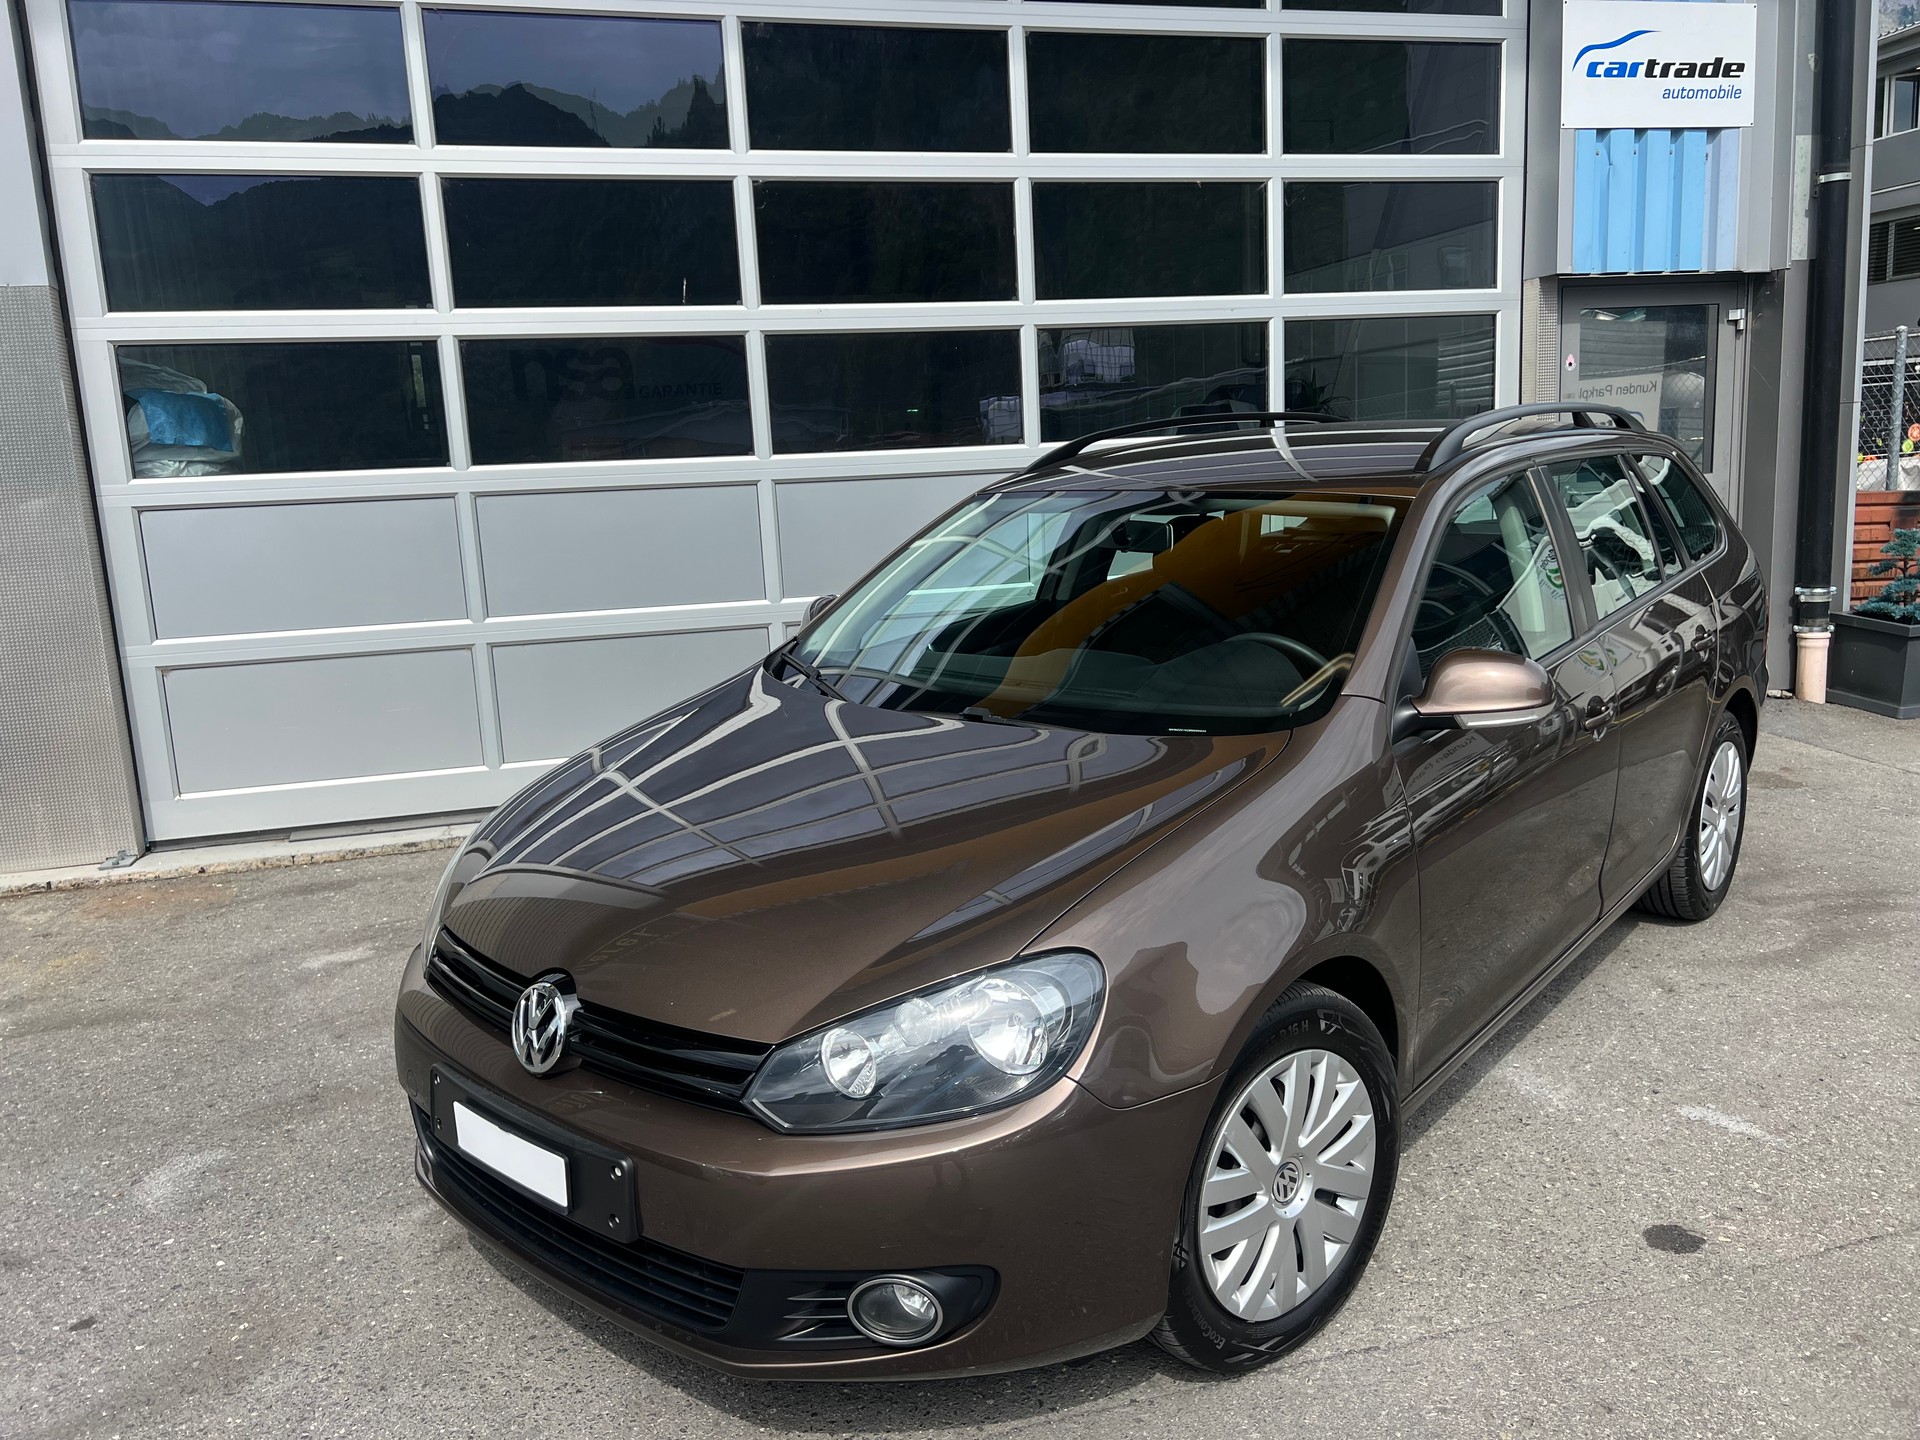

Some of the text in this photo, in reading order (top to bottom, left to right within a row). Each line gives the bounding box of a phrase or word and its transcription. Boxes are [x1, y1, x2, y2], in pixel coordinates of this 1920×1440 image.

[1586, 57, 1746, 79] cartrade
[1662, 84, 1742, 100] automobile
[639, 382, 723, 400] GARANTIE
